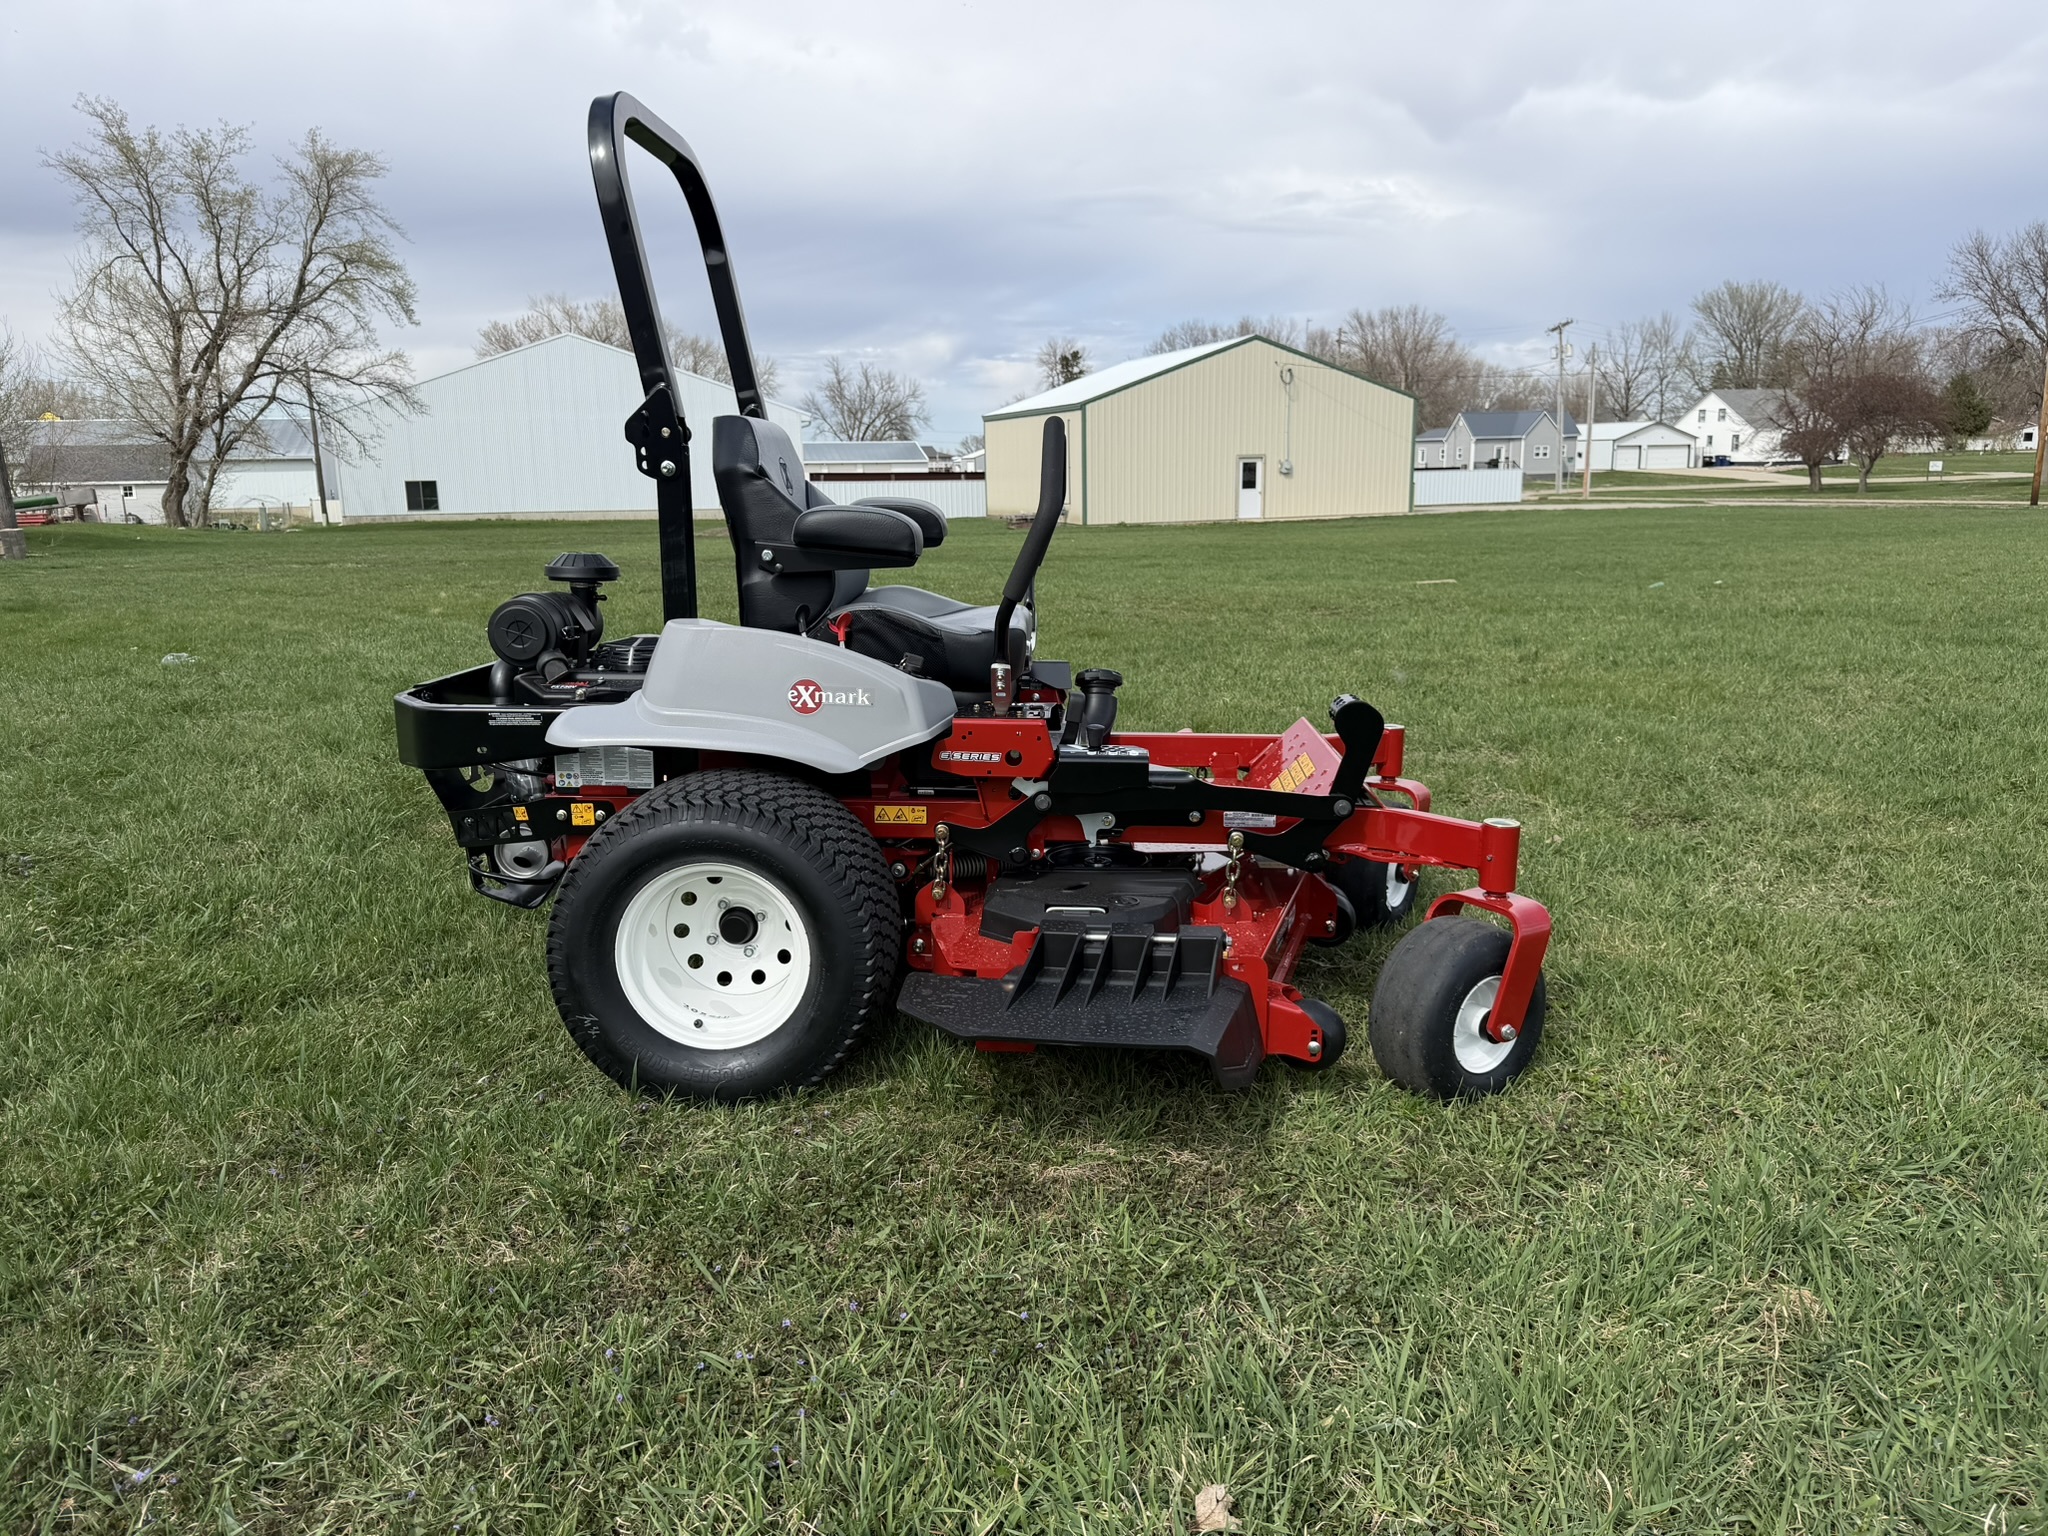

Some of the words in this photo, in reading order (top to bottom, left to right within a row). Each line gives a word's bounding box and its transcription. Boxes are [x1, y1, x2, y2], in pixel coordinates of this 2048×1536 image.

[788, 685, 870, 706] eXmark
[952, 751, 1002, 762] SERIES
[681, 1062, 757, 1082] HOOSIER
